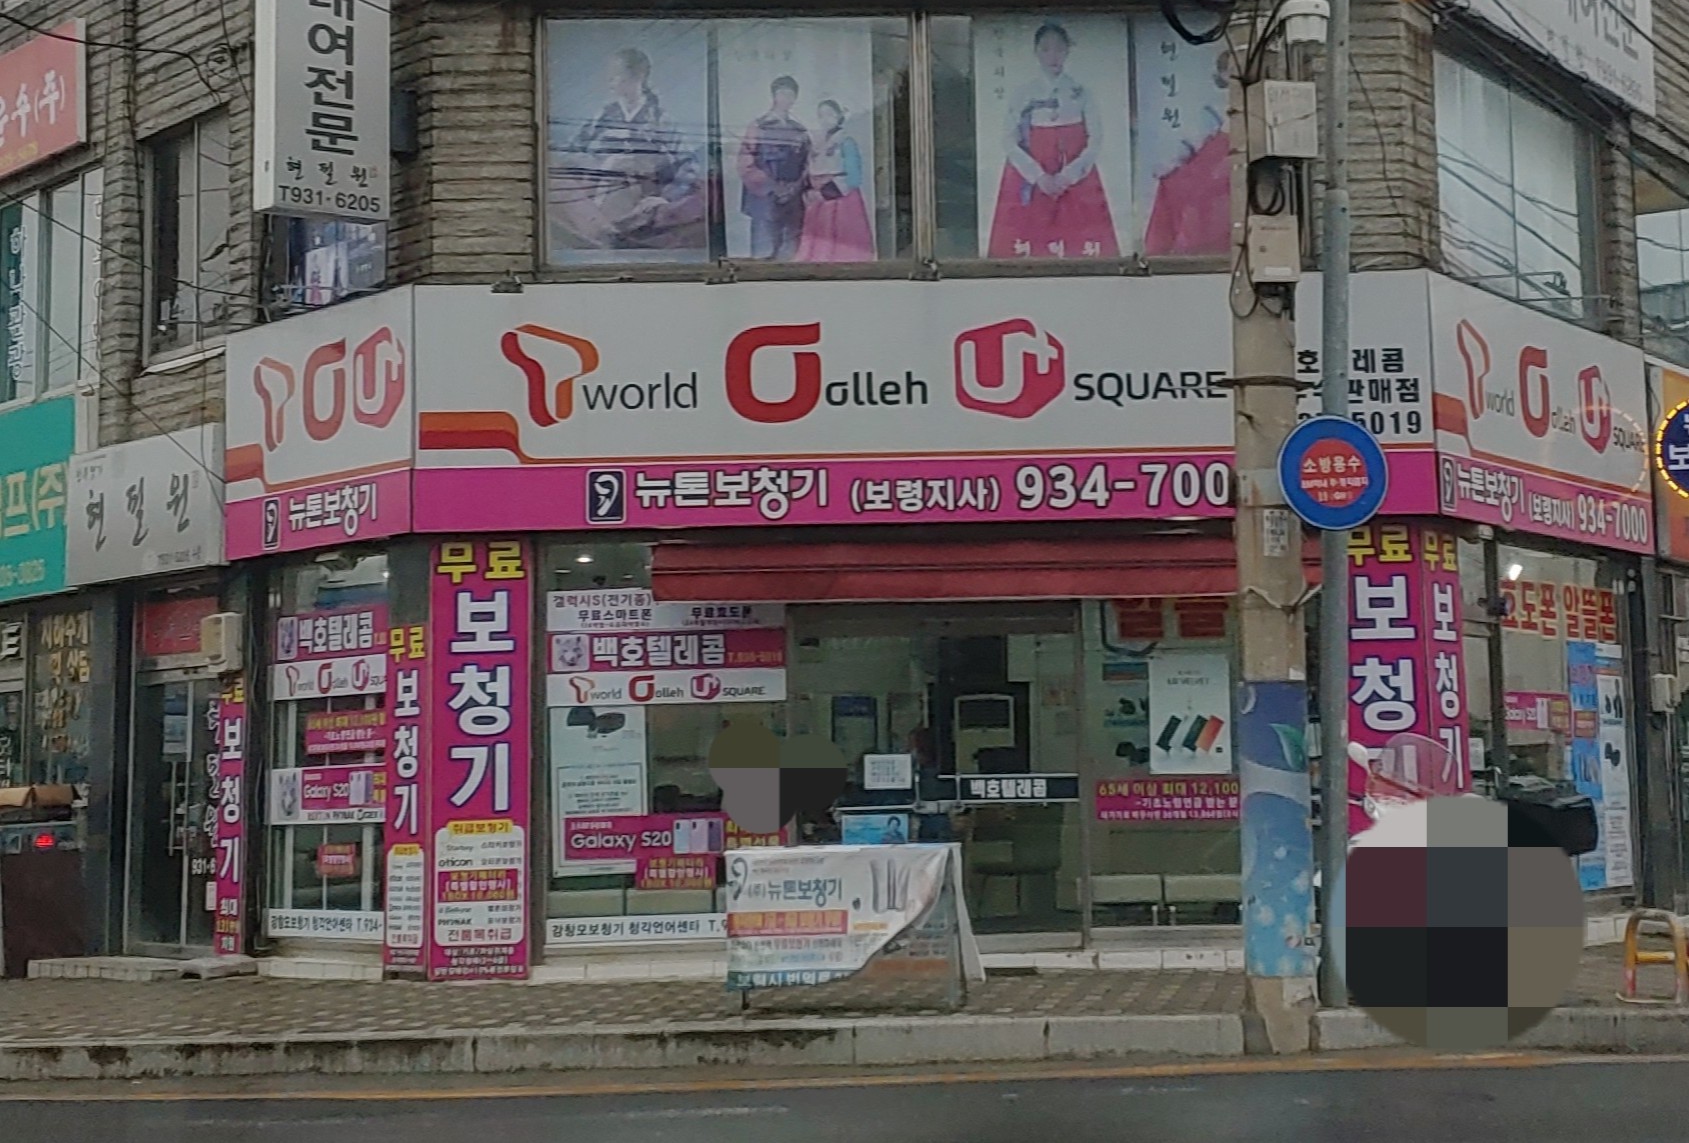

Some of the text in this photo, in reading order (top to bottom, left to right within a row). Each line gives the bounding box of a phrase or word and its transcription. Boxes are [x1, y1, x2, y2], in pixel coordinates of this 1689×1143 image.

[583, 371, 698, 410] world
[1074, 371, 1228, 406] SQUARE
[1303, 455, 1361, 474] 소방용수
[288, 483, 378, 538] 뉴톤보청기
[635, 469, 829, 521] 뉴톤보청기
[850, 478, 1000, 512] (보령지사)
[1456, 463, 1525, 522] 뉴톤보청기
[436, 541, 526, 584] 무료
[389, 626, 426, 662] 무료
[592, 633, 726, 668] 백호텔레콤
[447, 591, 517, 813] 보청기
[393, 669, 431, 836] 보청기
[220, 718, 244, 884] 보청기
[969, 778, 1047, 799] 백호텔레콤
[570, 831, 672, 851] Galaxy S20
